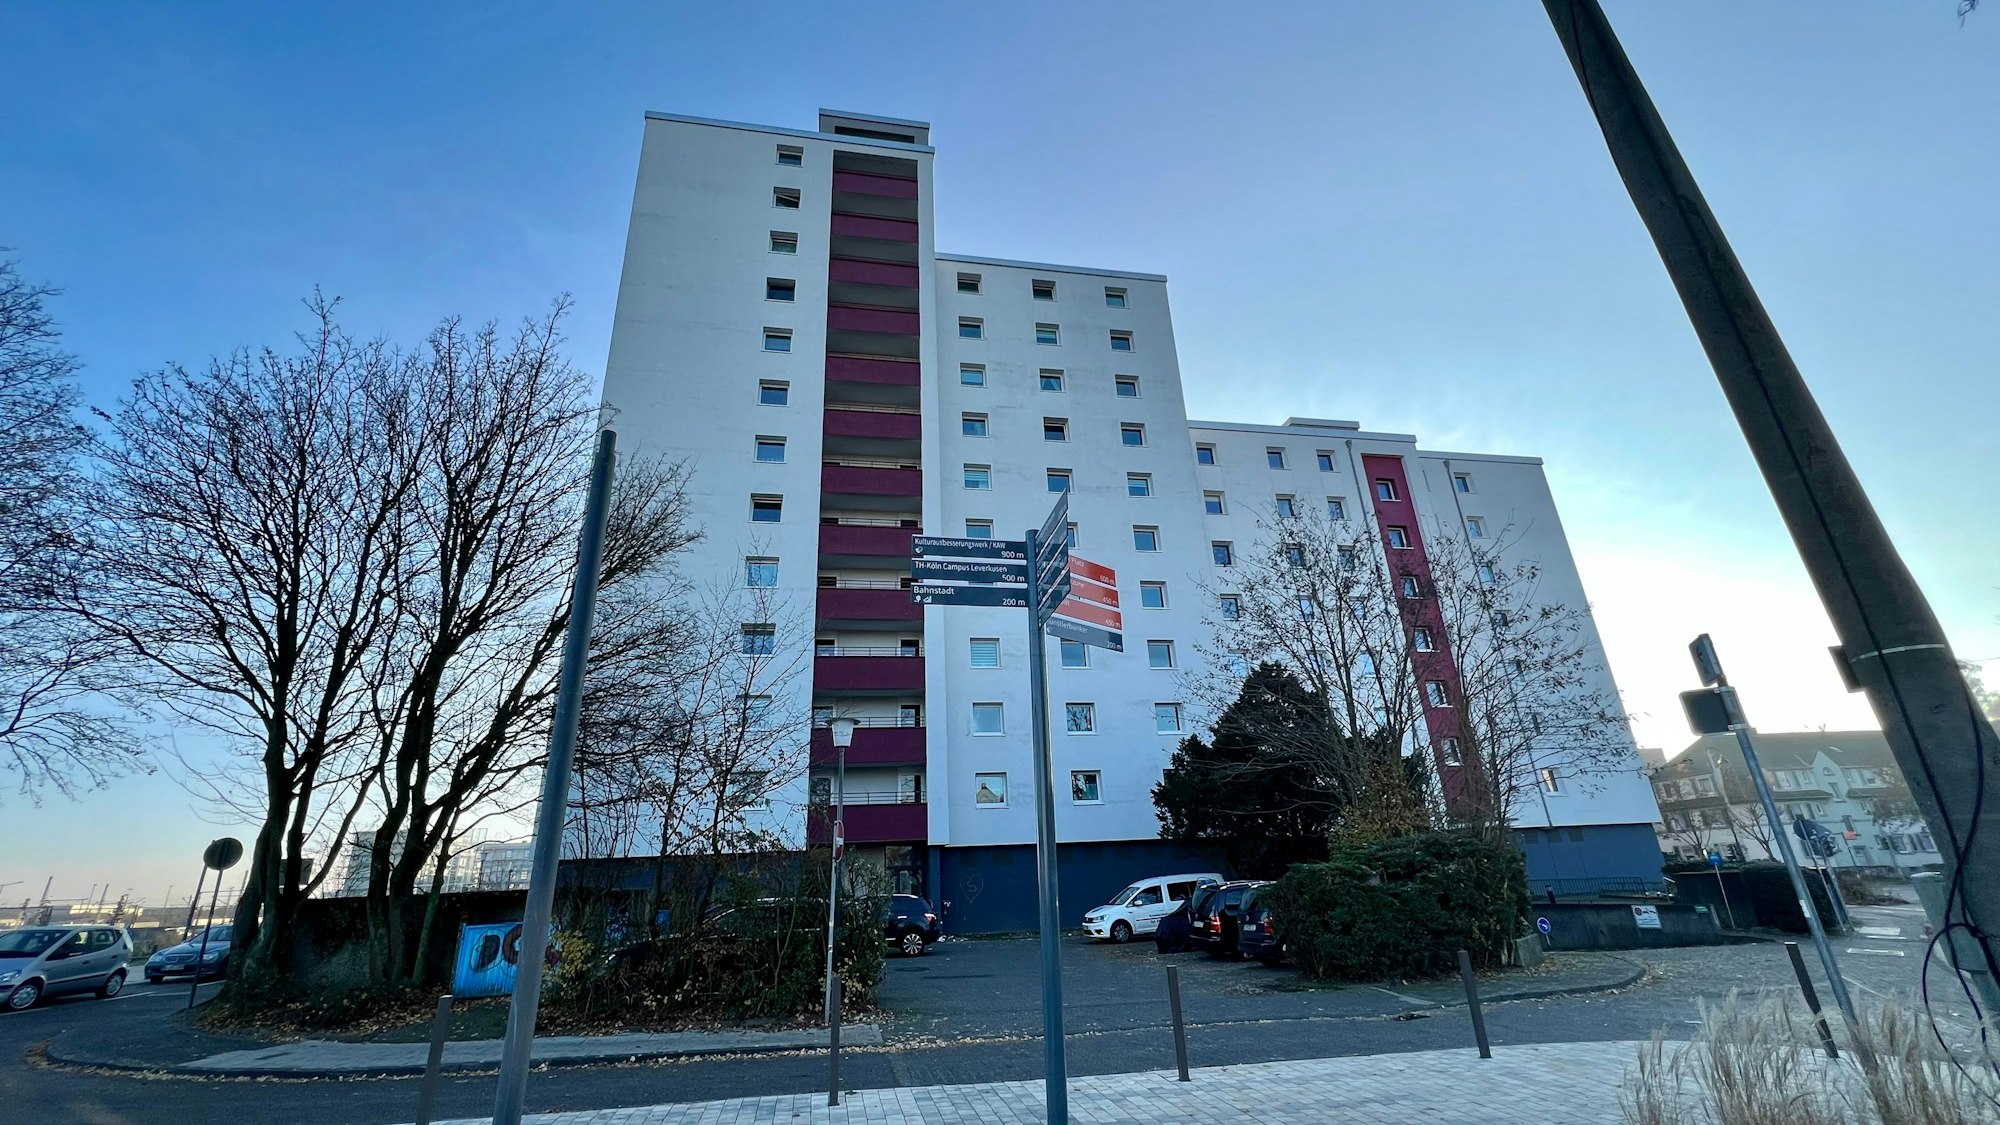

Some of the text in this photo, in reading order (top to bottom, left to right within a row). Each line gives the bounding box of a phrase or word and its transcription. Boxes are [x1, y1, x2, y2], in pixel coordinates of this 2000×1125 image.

[914, 538, 988, 549] Kulturausbesserungswerk
[915, 561, 1007, 573] TH-Köln Campus Leverkusen
[1002, 574, 1016, 582] 500
[913, 586, 955, 595] Bahnstadt
[1002, 598, 1016, 606] 200
[1049, 619, 1088, 633] ünstlerbunker
